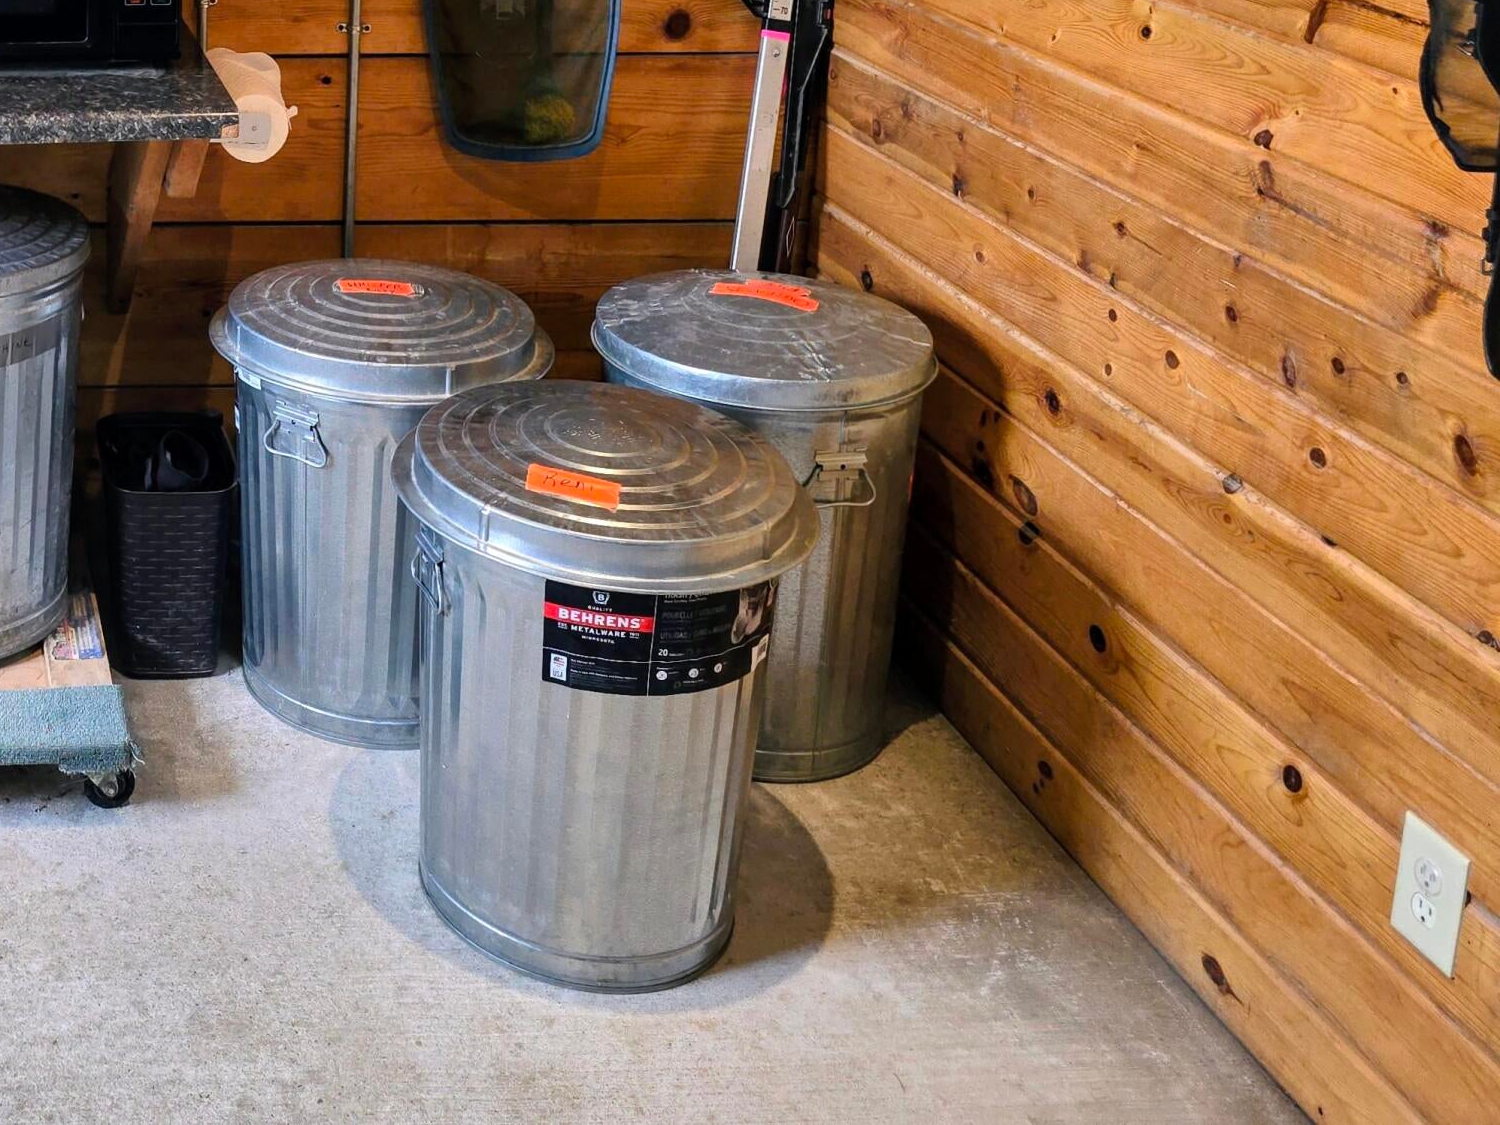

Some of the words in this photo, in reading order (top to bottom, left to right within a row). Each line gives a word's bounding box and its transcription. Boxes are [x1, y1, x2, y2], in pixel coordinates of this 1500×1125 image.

[558, 607, 641, 629] BEHRENS
[570, 624, 626, 638] METALWARE
[658, 648, 669, 657] 20
